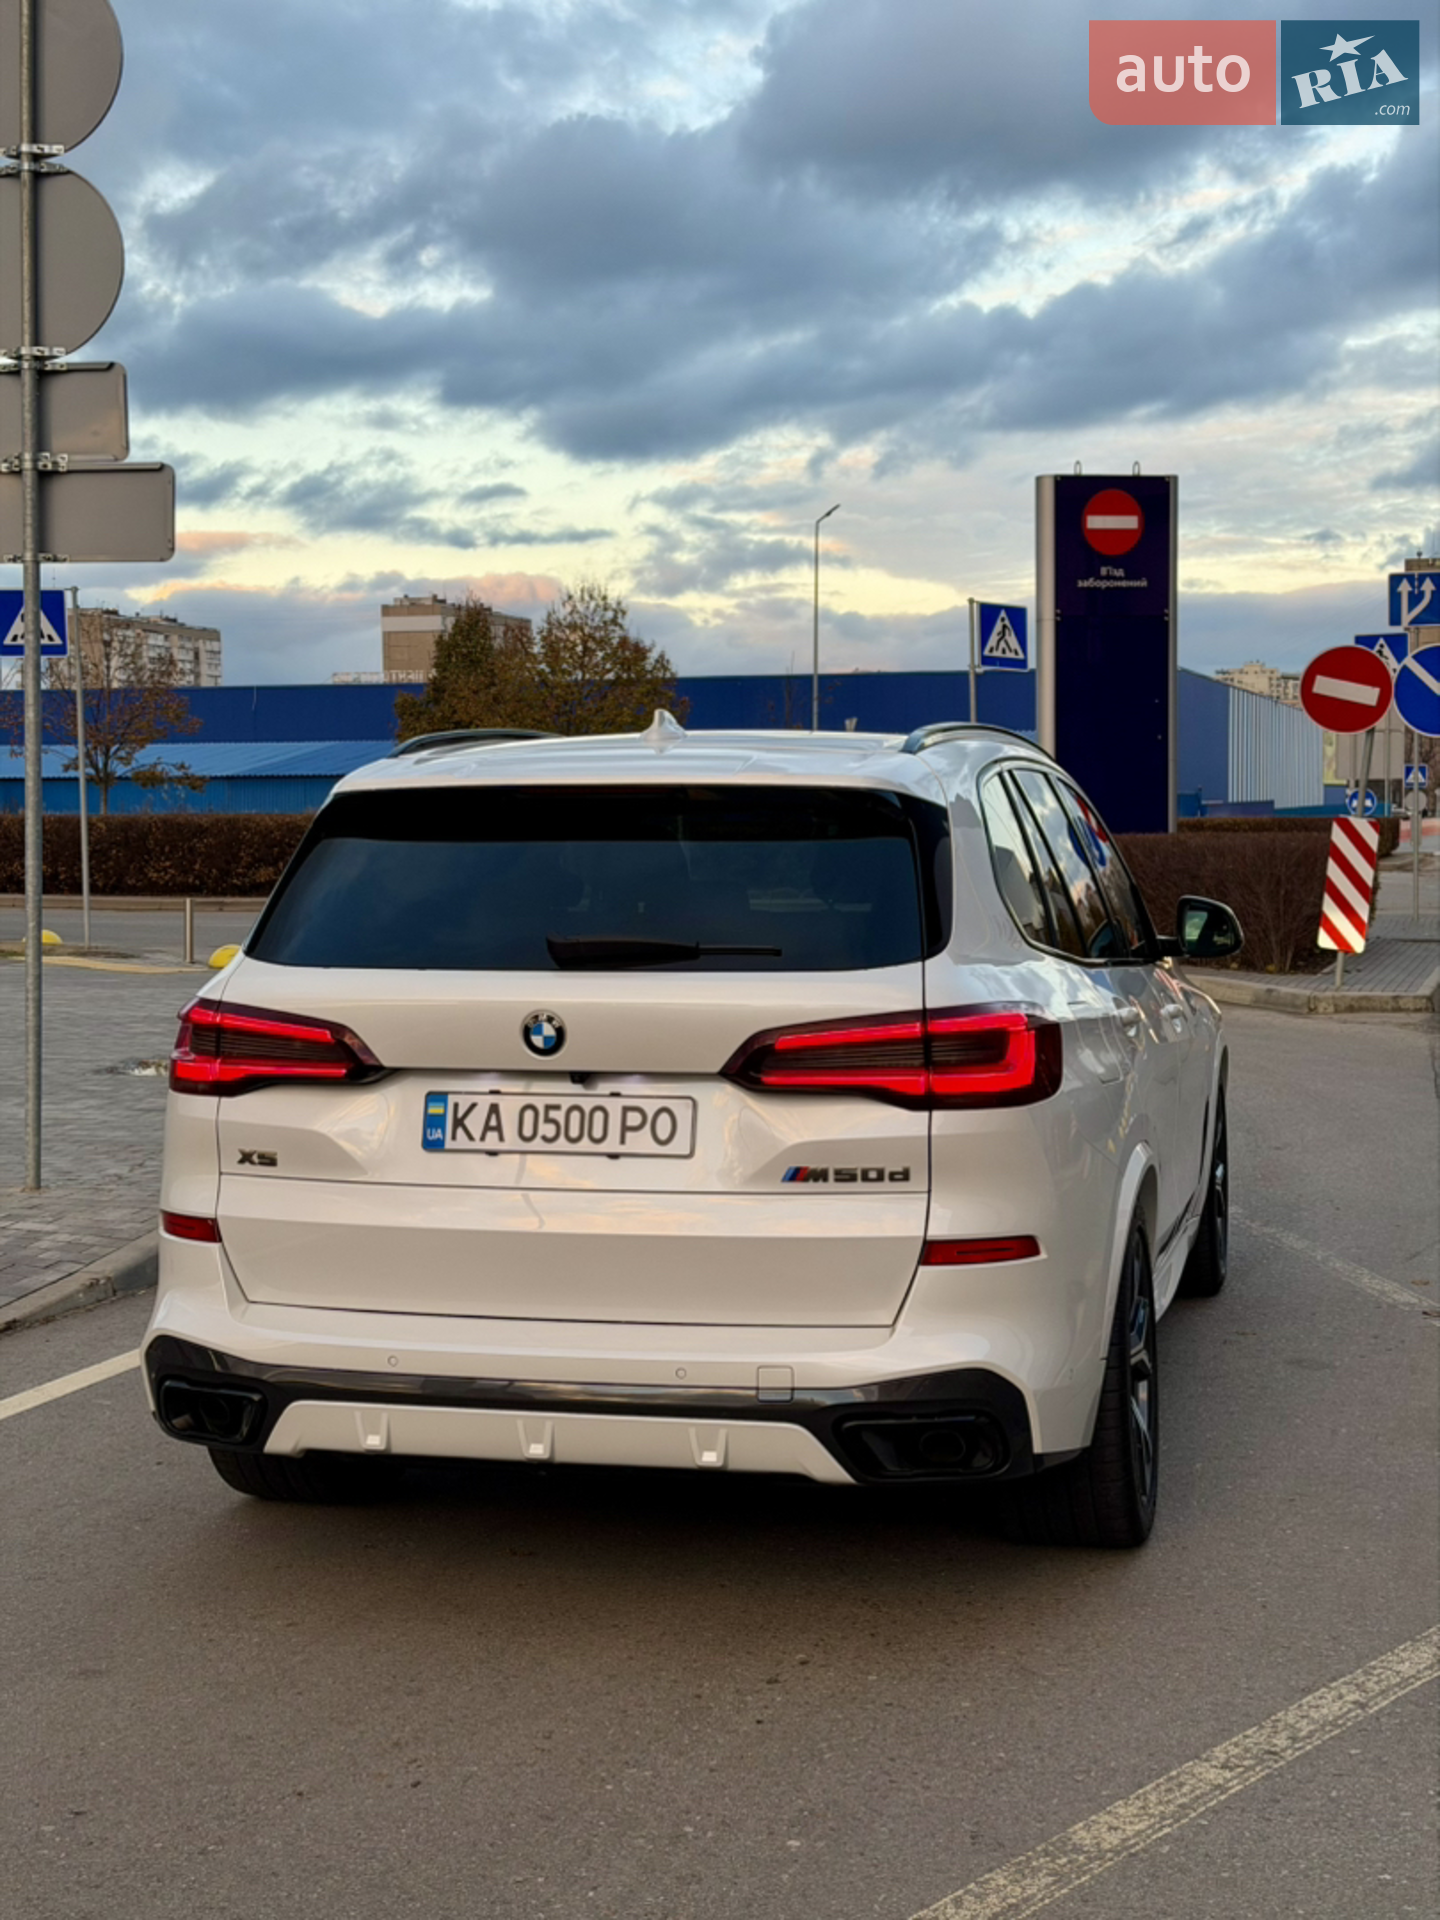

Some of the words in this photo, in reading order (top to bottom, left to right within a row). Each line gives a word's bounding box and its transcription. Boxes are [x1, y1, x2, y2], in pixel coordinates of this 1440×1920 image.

[1077, 577, 1148, 589] заборонений
[450, 1101, 505, 1143] KA
[517, 1103, 610, 1145] 0500
[619, 1105, 678, 1147] PO
[426, 1127, 443, 1141] UA
[236, 1149, 278, 1167] X5
